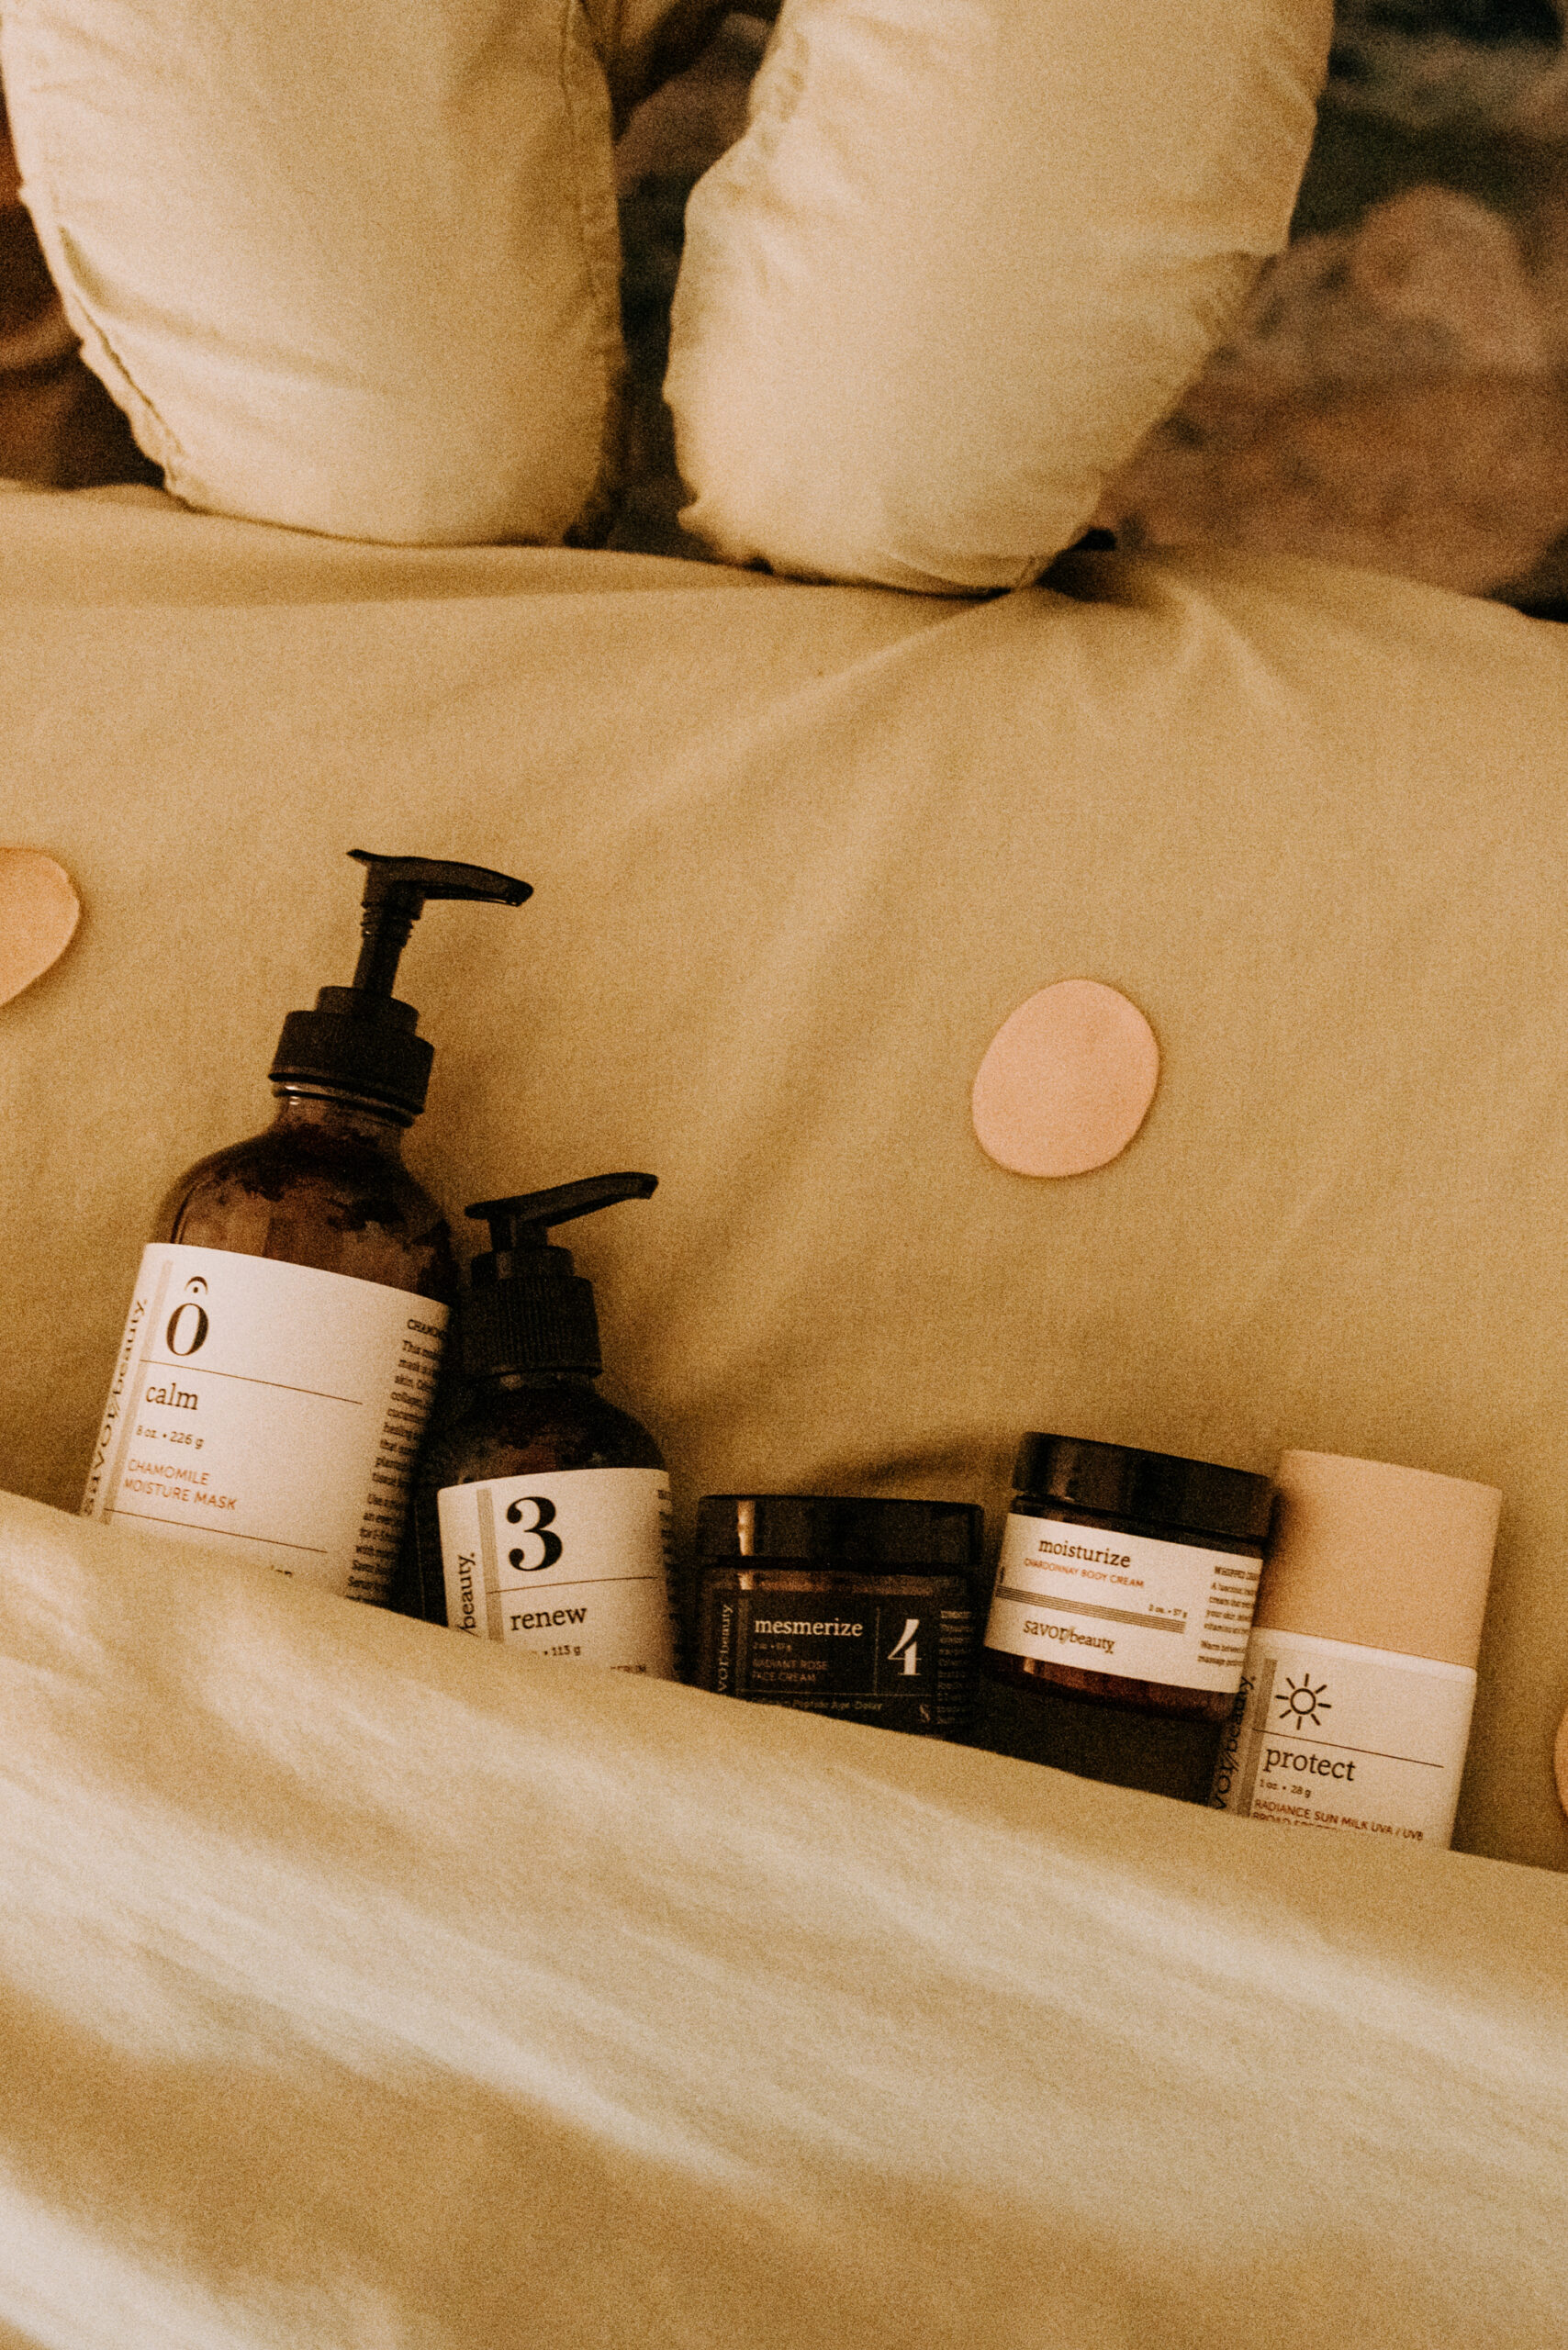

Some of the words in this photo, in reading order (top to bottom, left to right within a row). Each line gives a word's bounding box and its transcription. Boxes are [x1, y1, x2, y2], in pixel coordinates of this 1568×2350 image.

[146, 1382, 199, 1411] calm
[170, 1431, 193, 1446] 226
[195, 1438, 205, 1450] g
[128, 1459, 210, 1486] CHAMOMILE
[125, 1478, 191, 1503] MOISTURE
[194, 1491, 238, 1511] MASK
[507, 1496, 564, 1572] 3
[1038, 1539, 1132, 1569] moisturize
[1081, 1568, 1108, 1583] BODY
[1109, 1573, 1145, 1588] CREAM
[510, 1607, 588, 1631] renew
[755, 1617, 864, 1637] mesmerize
[573, 1645, 581, 1656] g
[887, 1618, 923, 1676] 4
[1262, 1749, 1356, 1781] protect
[1260, 1778, 1266, 1788] 1
[1291, 1785, 1303, 1795] 28
[1304, 1788, 1312, 1798] g
[1255, 1798, 1311, 1820] RADIANCE
[1314, 1810, 1339, 1825] SUN
[1341, 1816, 1368, 1830] MILK
[1371, 1823, 1394, 1836] UVA
[1402, 1829, 1424, 1841] UVB
